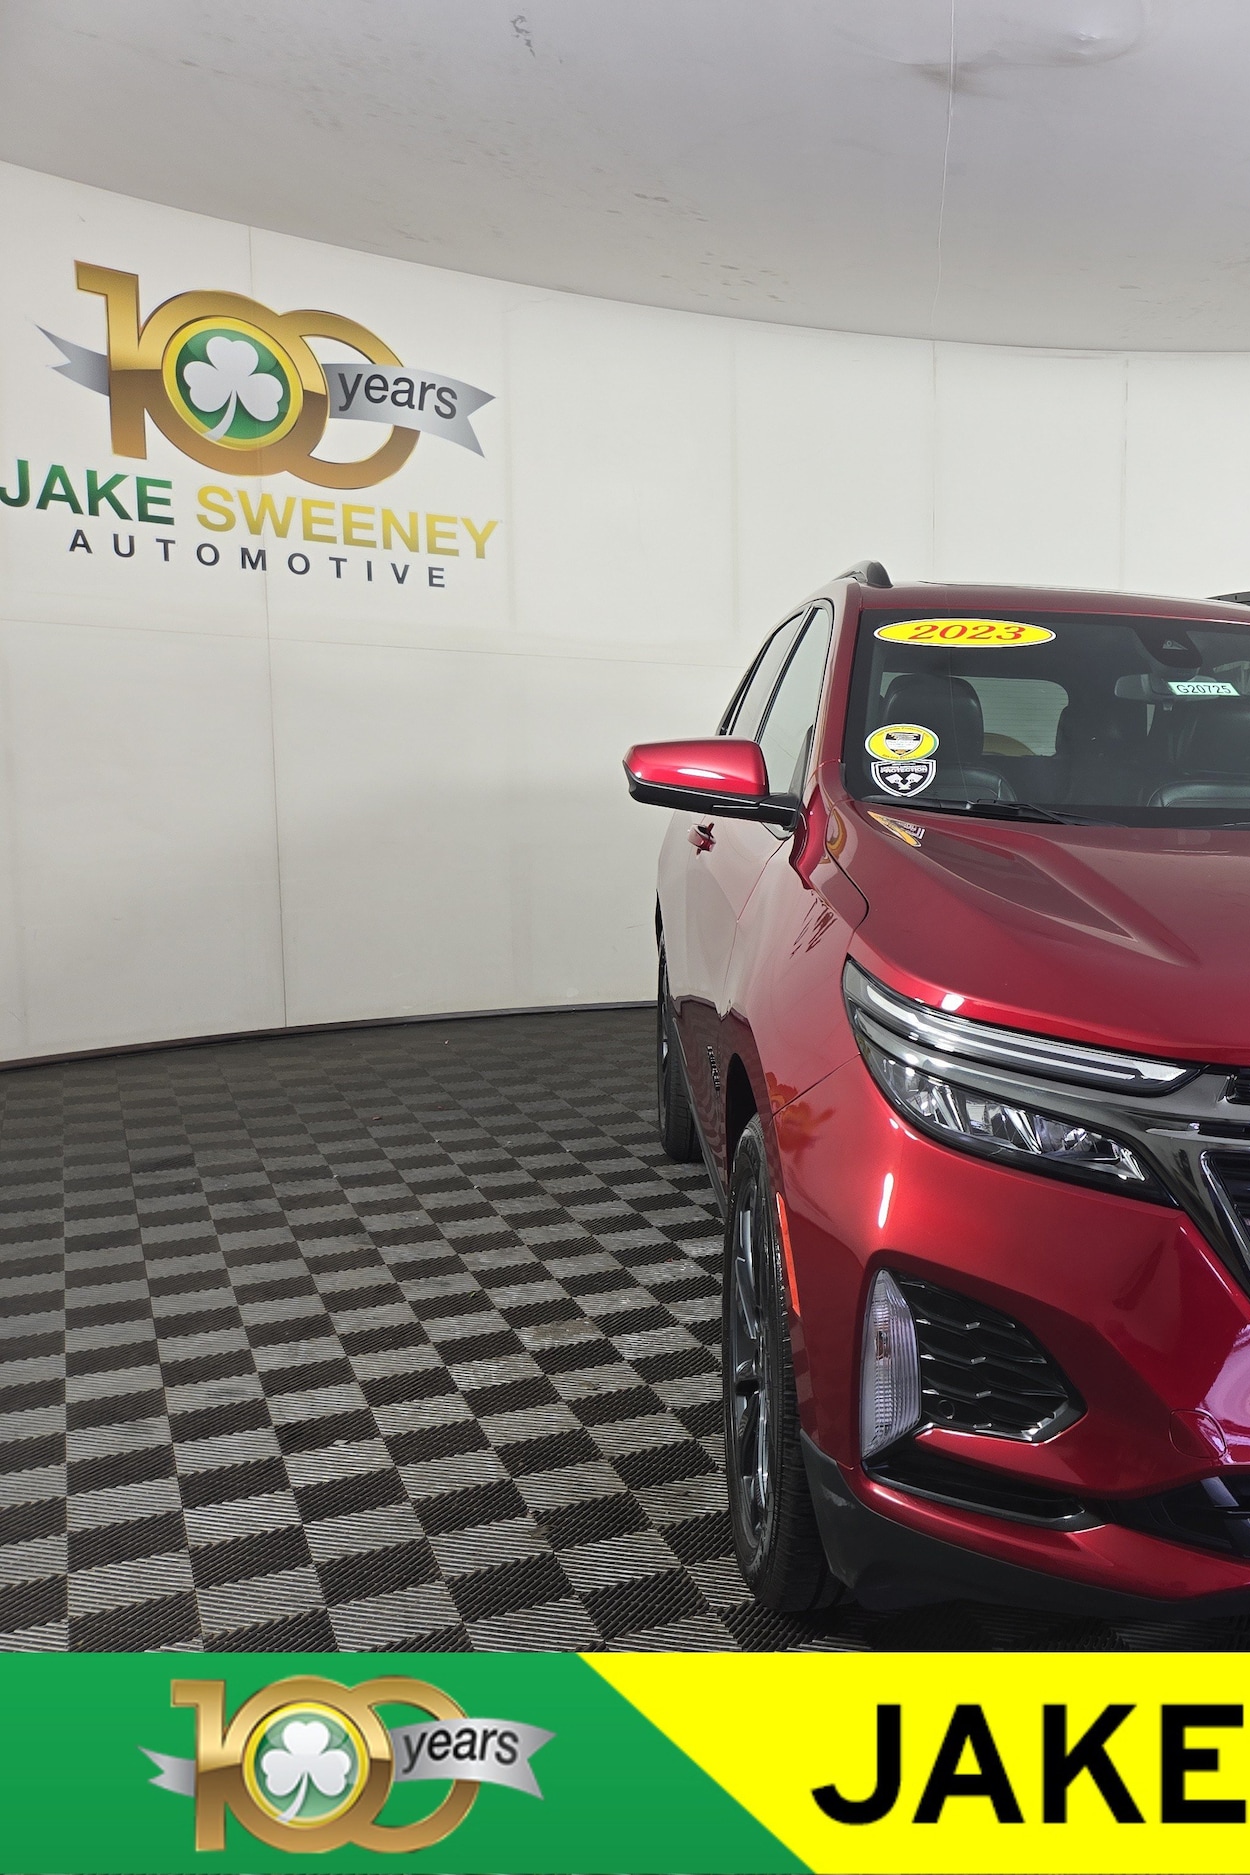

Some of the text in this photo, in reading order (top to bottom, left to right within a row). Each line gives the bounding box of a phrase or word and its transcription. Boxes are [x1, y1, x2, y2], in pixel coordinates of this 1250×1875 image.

[74, 260, 459, 490] 100 years
[0, 459, 499, 559] JAKE SWEENEY
[69, 529, 446, 588] AUTOMOTIVE
[908, 624, 1026, 641] 2023
[1176, 684, 1232, 694] G20725
